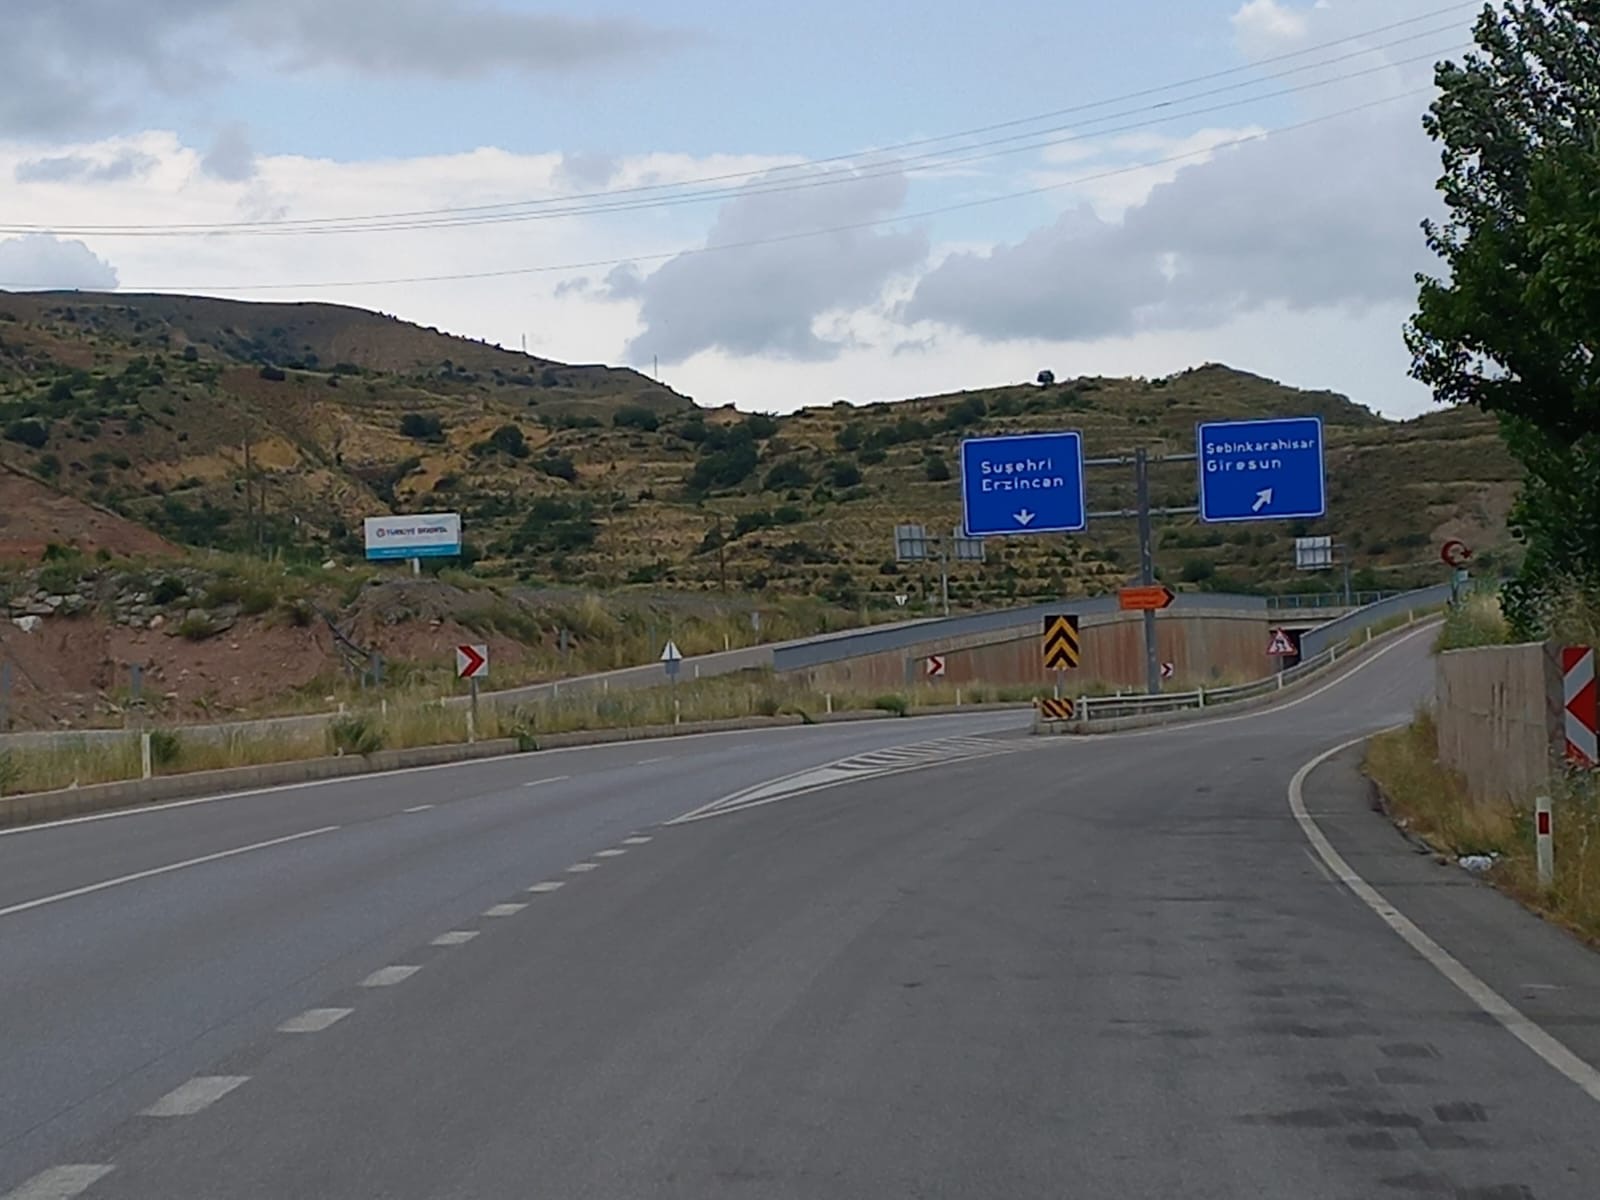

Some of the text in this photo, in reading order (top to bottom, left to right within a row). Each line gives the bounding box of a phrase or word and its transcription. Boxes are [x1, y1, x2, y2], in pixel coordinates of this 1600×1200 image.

[981, 457, 1052, 475] Suşehri
[1206, 458, 1282, 472] Giresun
[982, 476, 1064, 492] Erzincan
